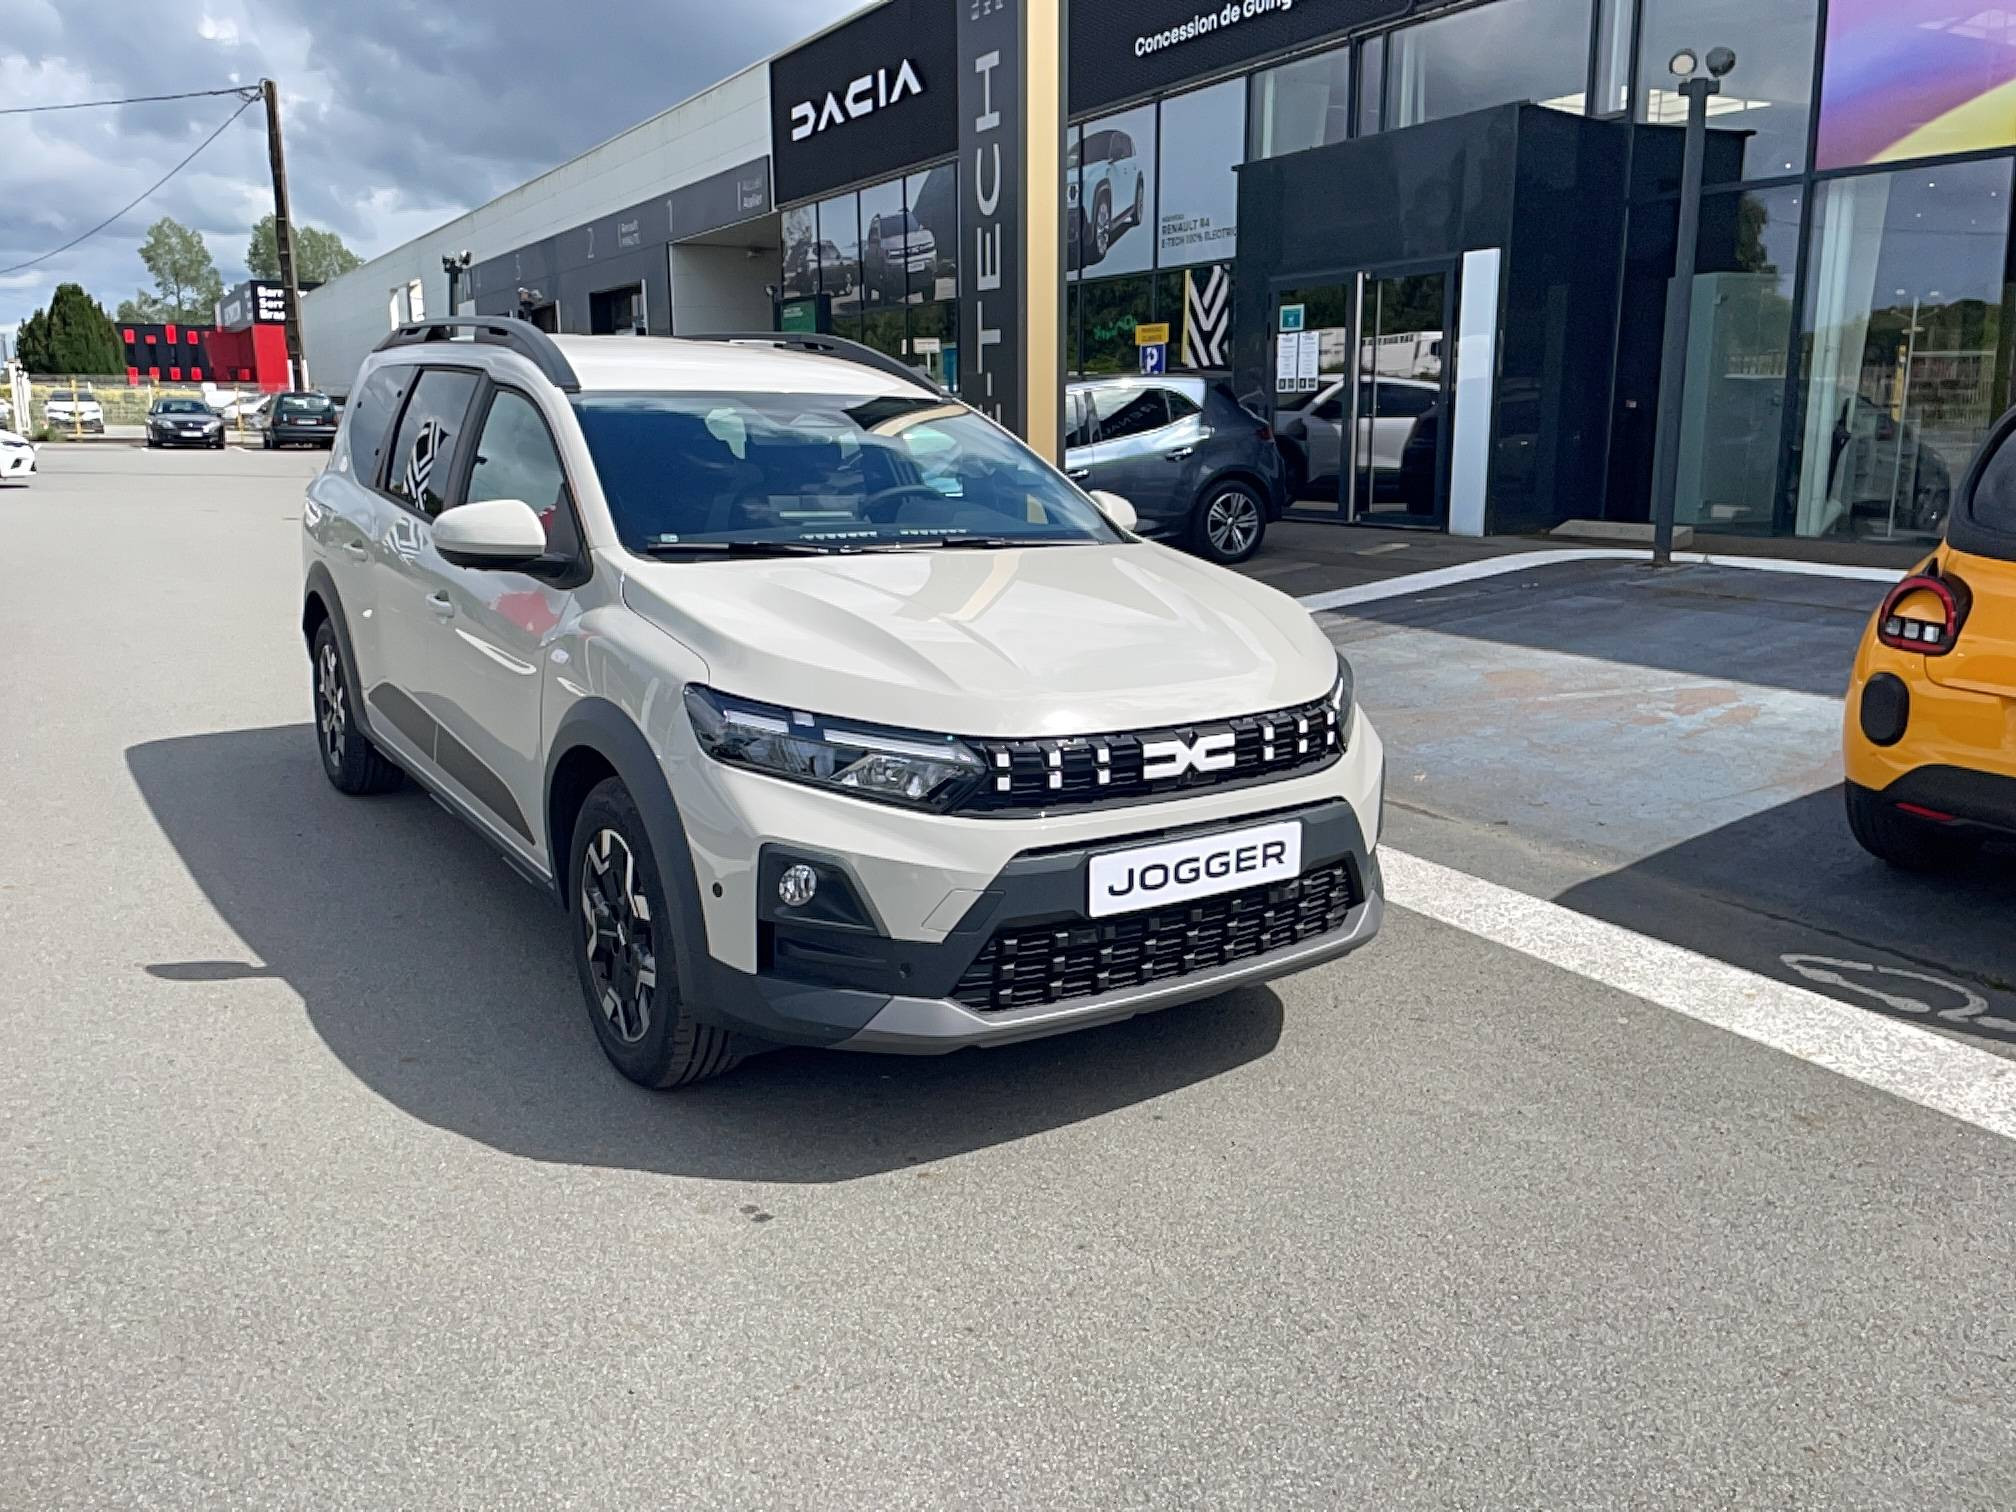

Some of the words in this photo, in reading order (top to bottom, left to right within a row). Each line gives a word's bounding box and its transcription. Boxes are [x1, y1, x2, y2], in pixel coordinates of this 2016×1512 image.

[1134, 13, 1218, 57] Concession
[1219, 3, 1241, 26] de
[791, 58, 922, 142] DACIA
[976, 49, 1001, 425] -TECH
[1162, 219, 1198, 235] RENAULT
[1108, 841, 1286, 896] JOGGER
